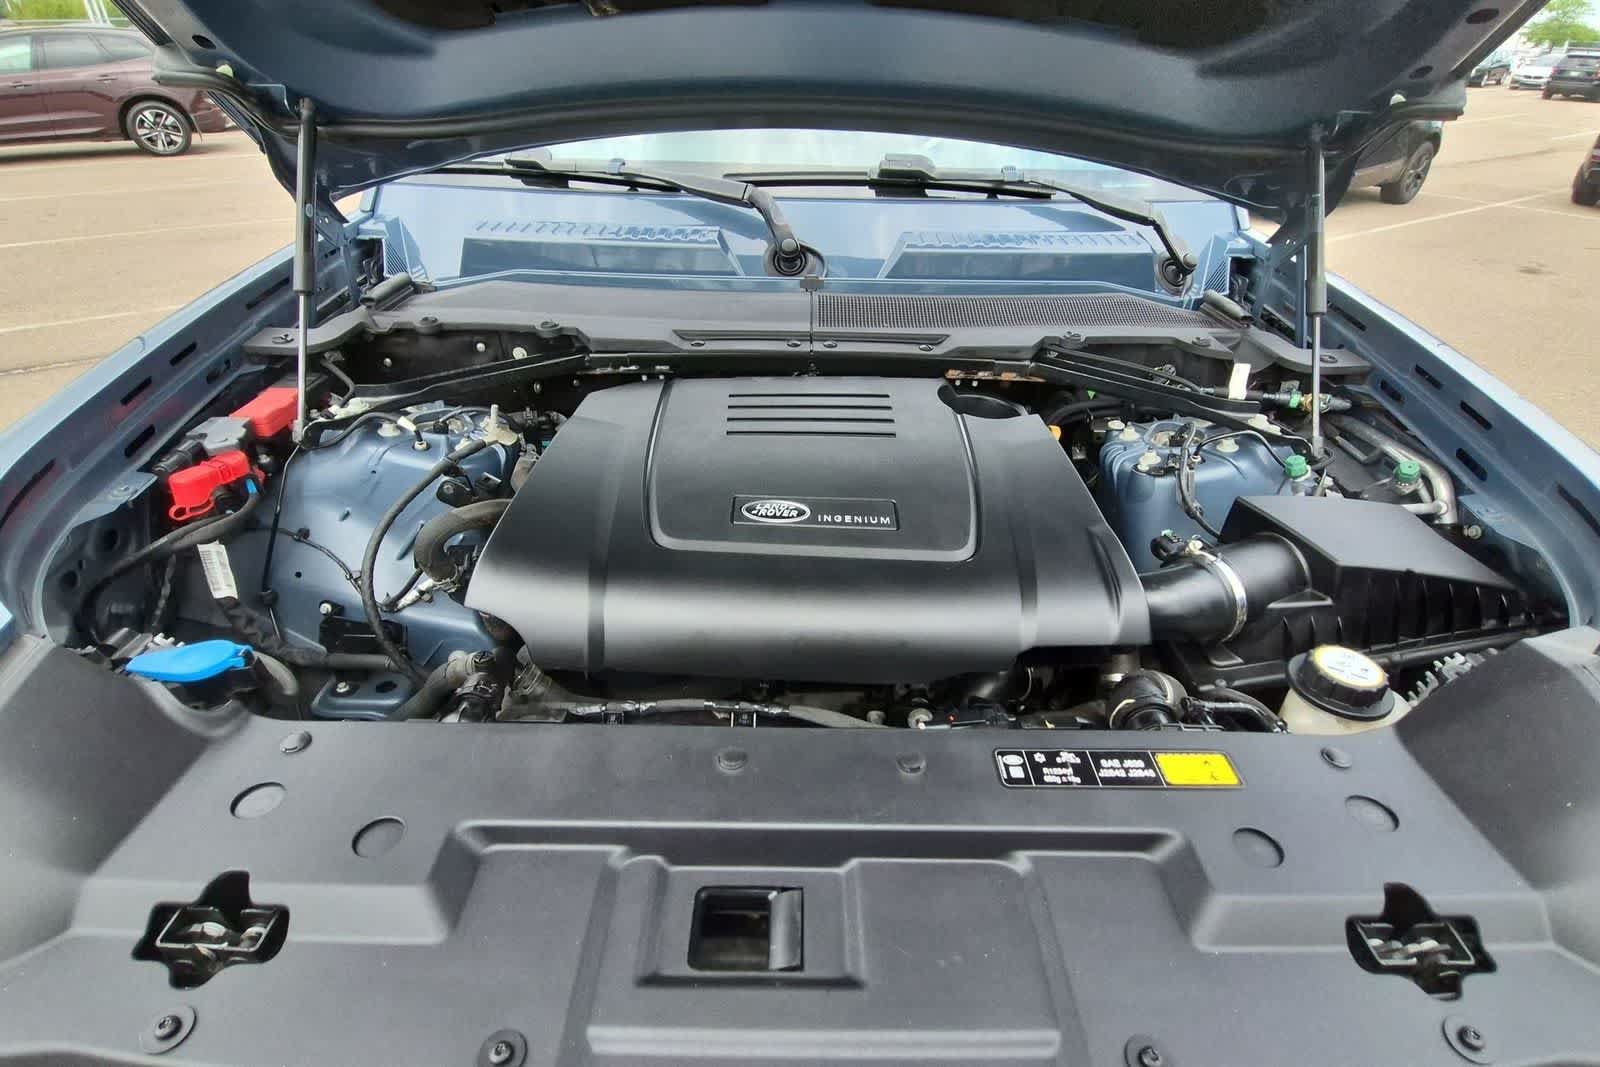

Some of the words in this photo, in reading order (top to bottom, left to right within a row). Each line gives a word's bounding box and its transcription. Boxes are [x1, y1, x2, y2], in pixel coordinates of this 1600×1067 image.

[756, 502, 787, 510] LAND
[758, 508, 799, 517] ROVER
[817, 514, 891, 525] INGENIUM
